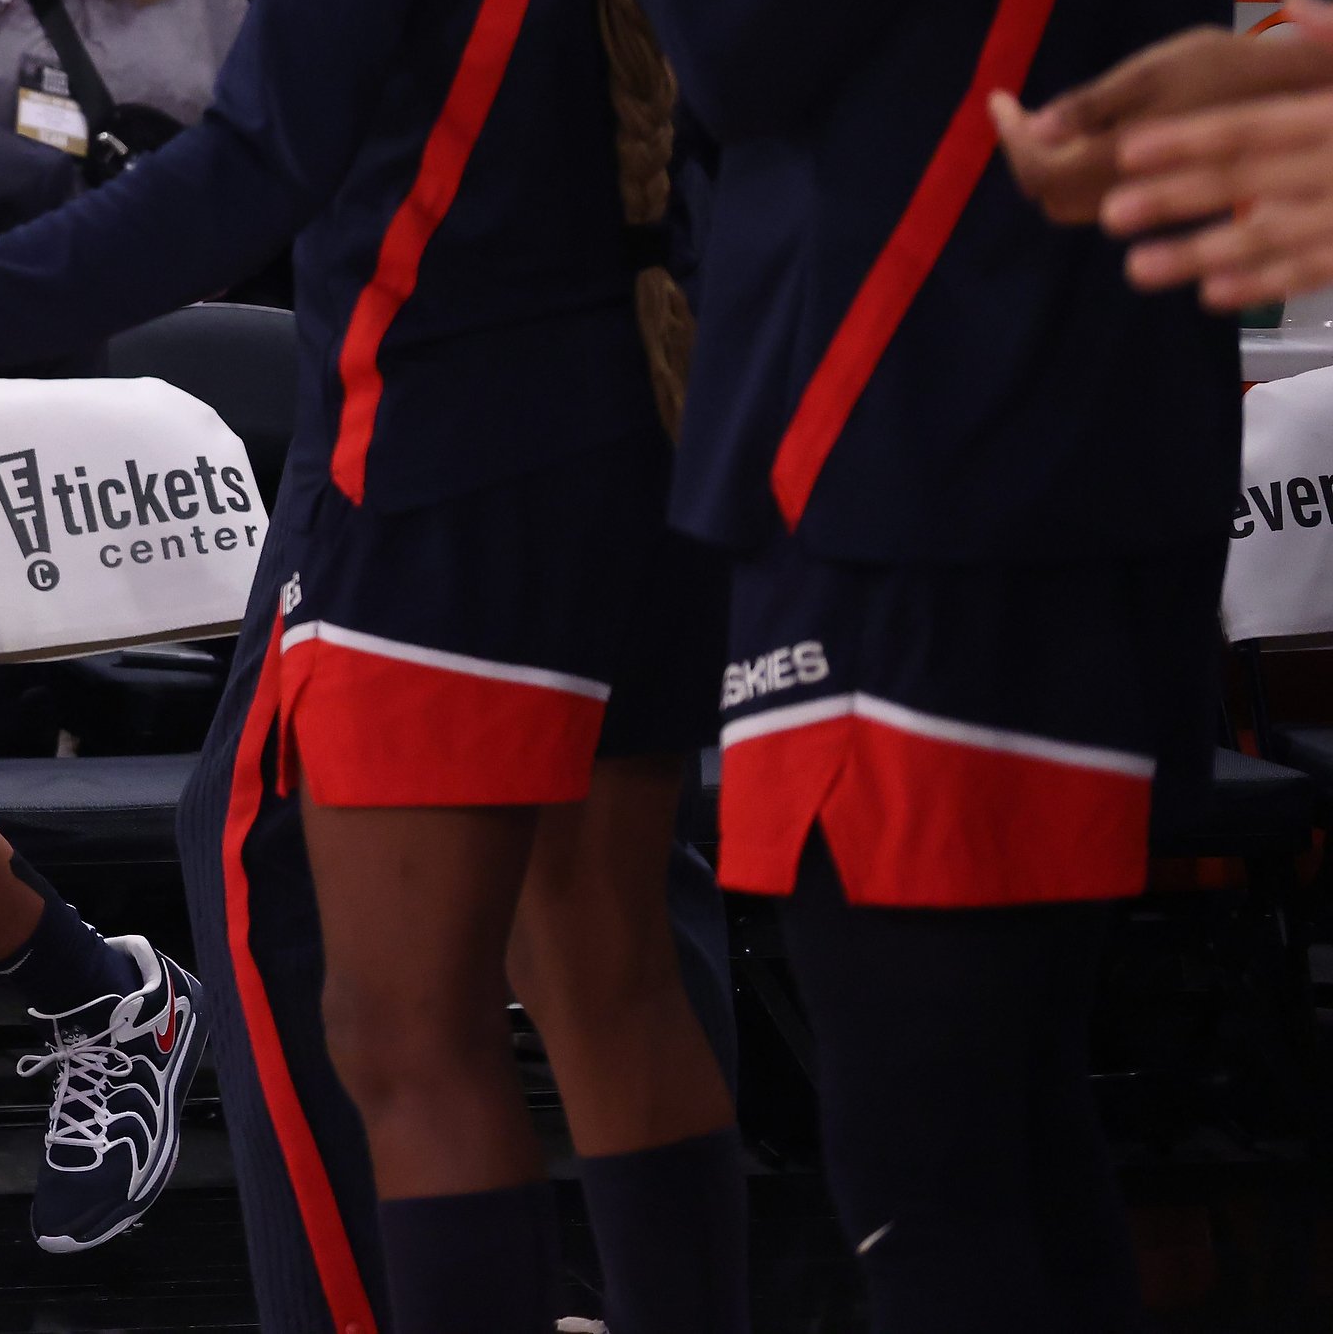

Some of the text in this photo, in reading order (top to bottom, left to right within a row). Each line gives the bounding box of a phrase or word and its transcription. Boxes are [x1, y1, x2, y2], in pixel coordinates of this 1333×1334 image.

[52, 456, 251, 535] tickets
[100, 526, 258, 568] center
[718, 639, 830, 712] SKIES
